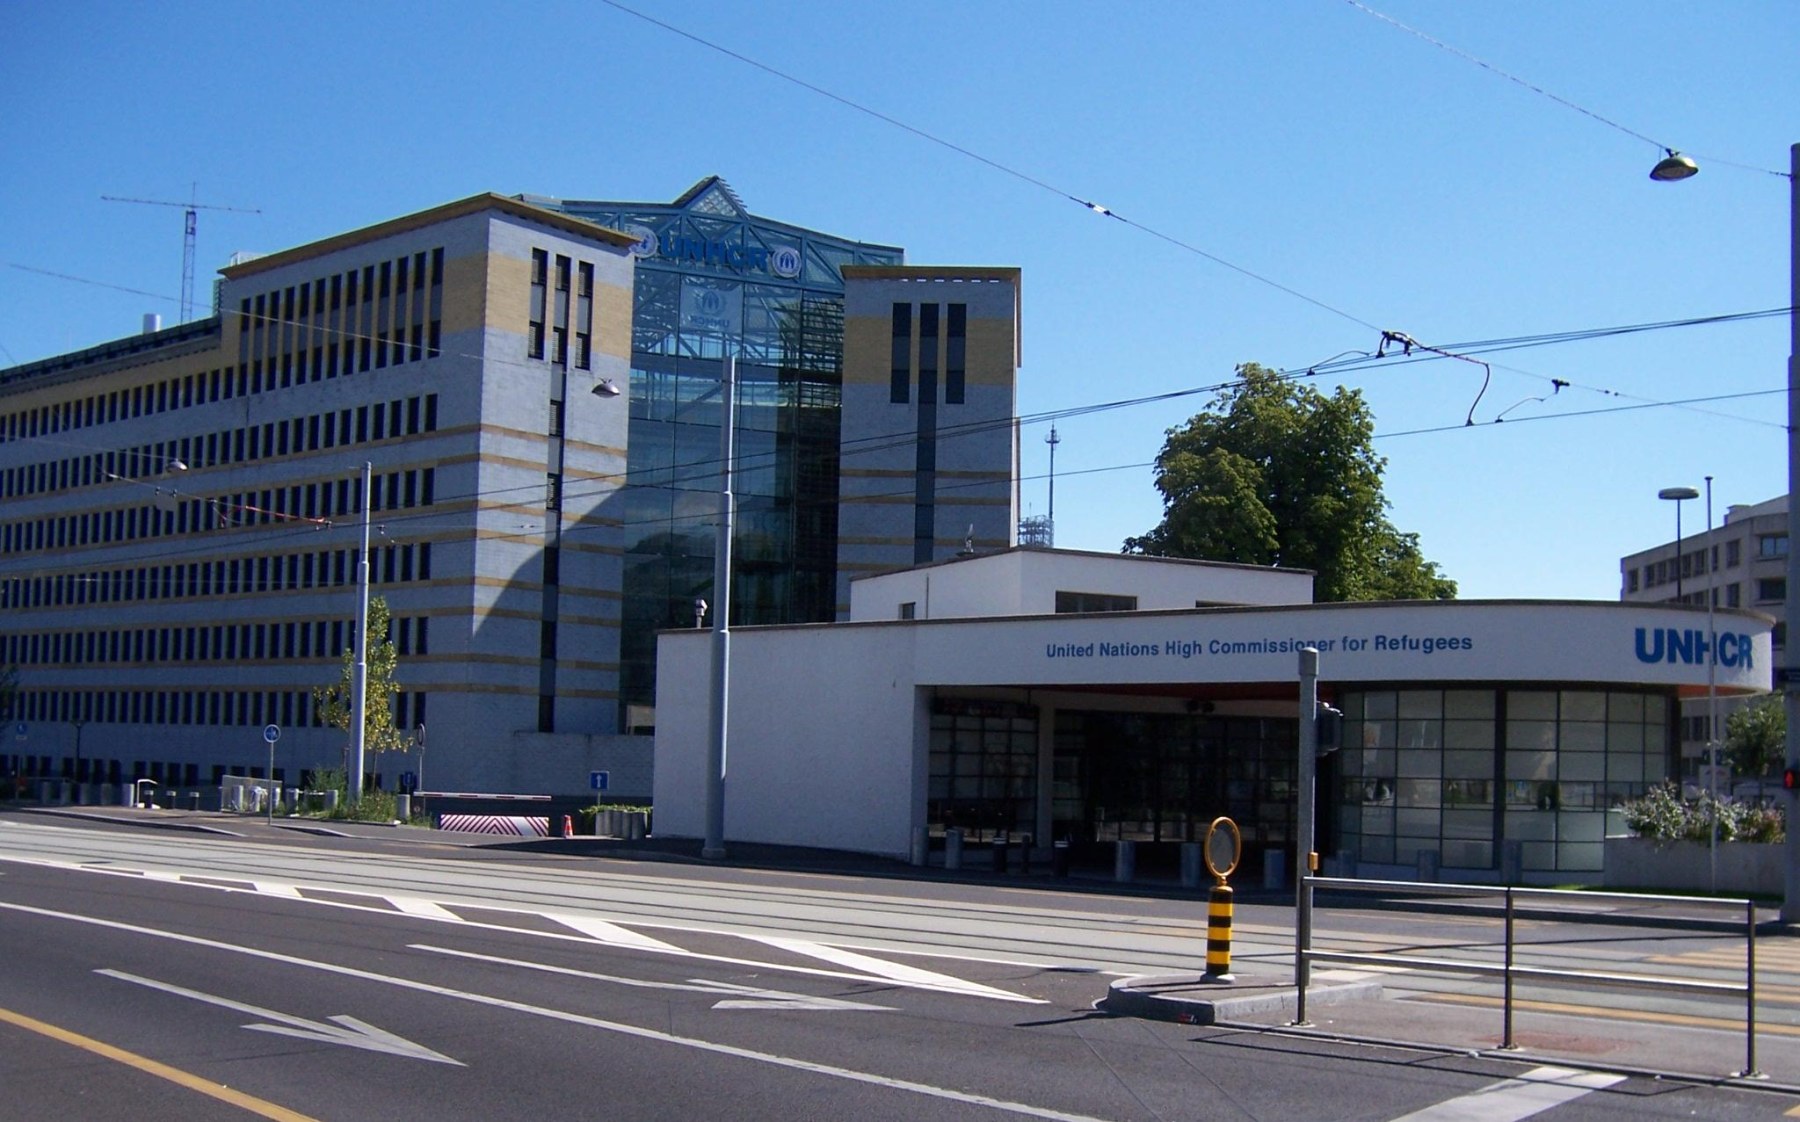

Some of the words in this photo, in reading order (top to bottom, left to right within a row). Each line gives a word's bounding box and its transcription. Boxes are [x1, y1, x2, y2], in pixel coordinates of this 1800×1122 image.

[660, 233, 768, 272] UNHCR
[1047, 642, 1094, 658] United
[1100, 642, 1159, 656] Nations
[1165, 640, 1202, 658] High
[1209, 638, 1335, 654] Commissioner
[1342, 635, 1368, 651] for
[1375, 634, 1472, 654] Refugees
[1635, 628, 1753, 671] UNHCR
